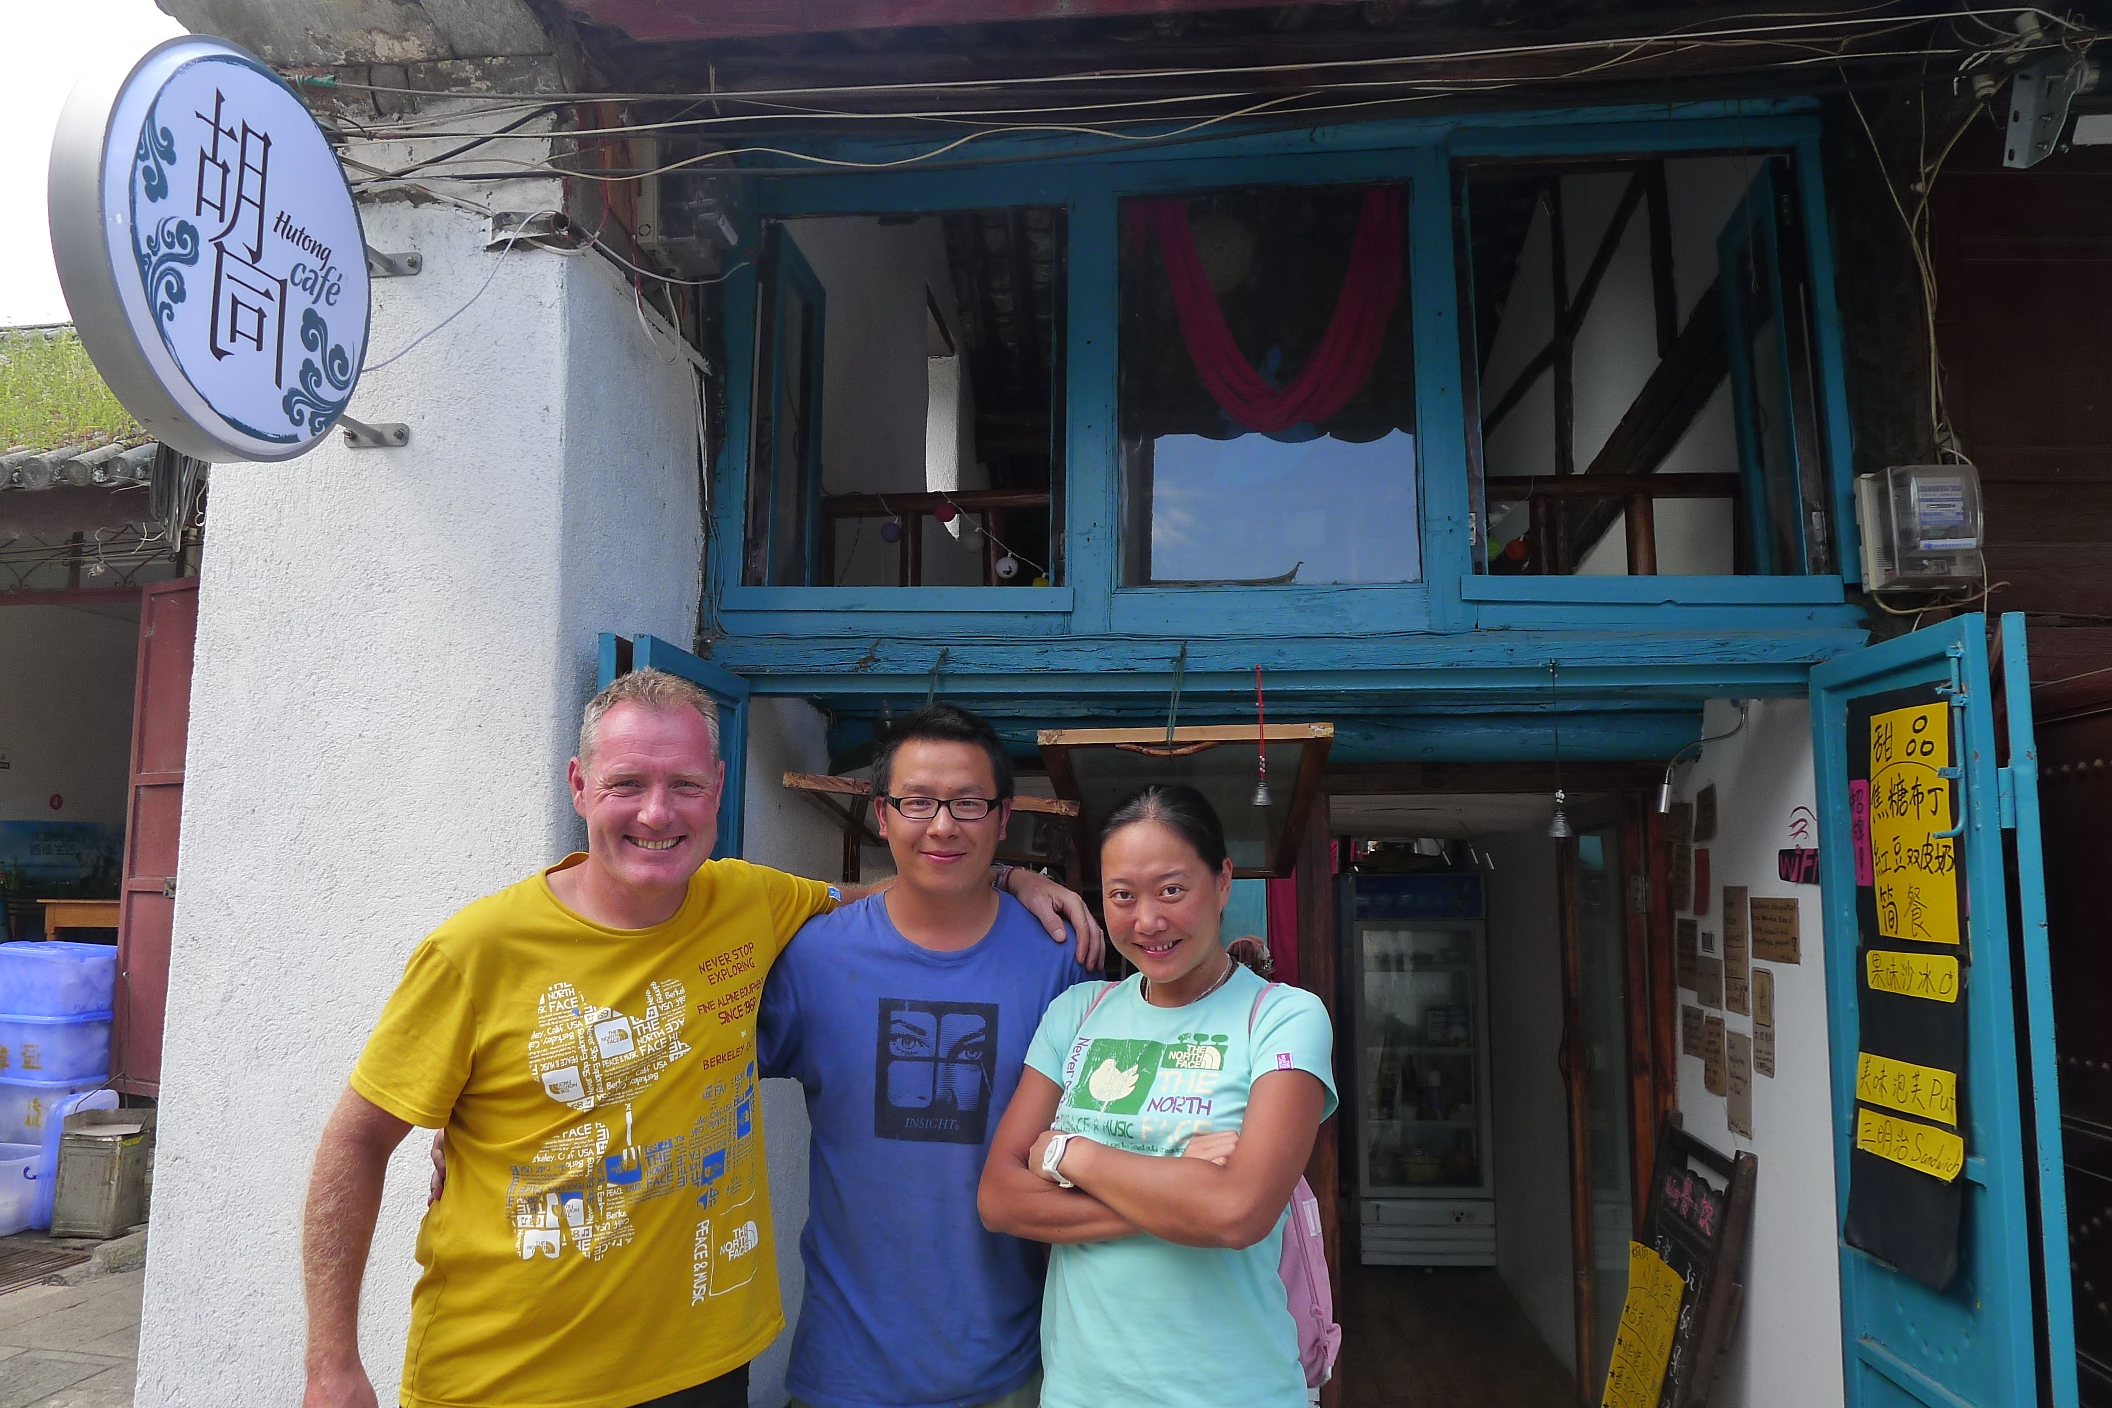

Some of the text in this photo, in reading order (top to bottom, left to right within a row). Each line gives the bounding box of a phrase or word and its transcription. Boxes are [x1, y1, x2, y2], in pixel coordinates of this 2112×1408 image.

[195, 87, 288, 390] 胡同
[273, 210, 331, 273] Hutong
[290, 262, 343, 307] café
[1873, 714, 1935, 763] 甜品
[1871, 772, 1945, 824] 焦糖布丁
[1879, 884, 1932, 938] 简餐
[698, 941, 754, 975] NEVER STOP
[707, 957, 756, 986] EXPLORING
[1871, 953, 1936, 995] 果味沙冰
[548, 988, 576, 1001] NORTH
[549, 997, 579, 1013] FACE
[697, 1000, 716, 1015] FINE
[717, 989, 740, 1008] ALPINE
[718, 1003, 744, 1026] SINCE
[566, 1020, 584, 1031] USA
[633, 1018, 660, 1036] THE
[637, 1029, 666, 1046] NORTH
[639, 1037, 667, 1057] FACE
[703, 1044, 745, 1071] BERKELEY
[1066, 1036, 1092, 1078] Never
[1168, 1050, 1204, 1061] NORTH
[1187, 1044, 1207, 1054] THE
[652, 1060, 668, 1071] USA
[1175, 1059, 1202, 1069] FACE
[1158, 1071, 1221, 1095] THE
[1861, 1057, 1926, 1111] 美味泡芙
[1146, 1095, 1213, 1116] NORTH
[905, 1117, 957, 1130] INSIGHT
[1102, 1118, 1134, 1139] MUSIC
[1141, 1115, 1213, 1143] FACE
[577, 1148, 595, 1158] USA
[645, 1149, 672, 1167] THE
[1861, 1119, 1960, 1176] 三明治 Sandwich
[646, 1162, 673, 1177] NORTH
[646, 1171, 674, 1189] FACE
[732, 1223, 748, 1238] THE
[720, 1235, 748, 1256] NORTH
[728, 1243, 750, 1261] FACE
[691, 1219, 710, 1307] PEACE & MUSIC
